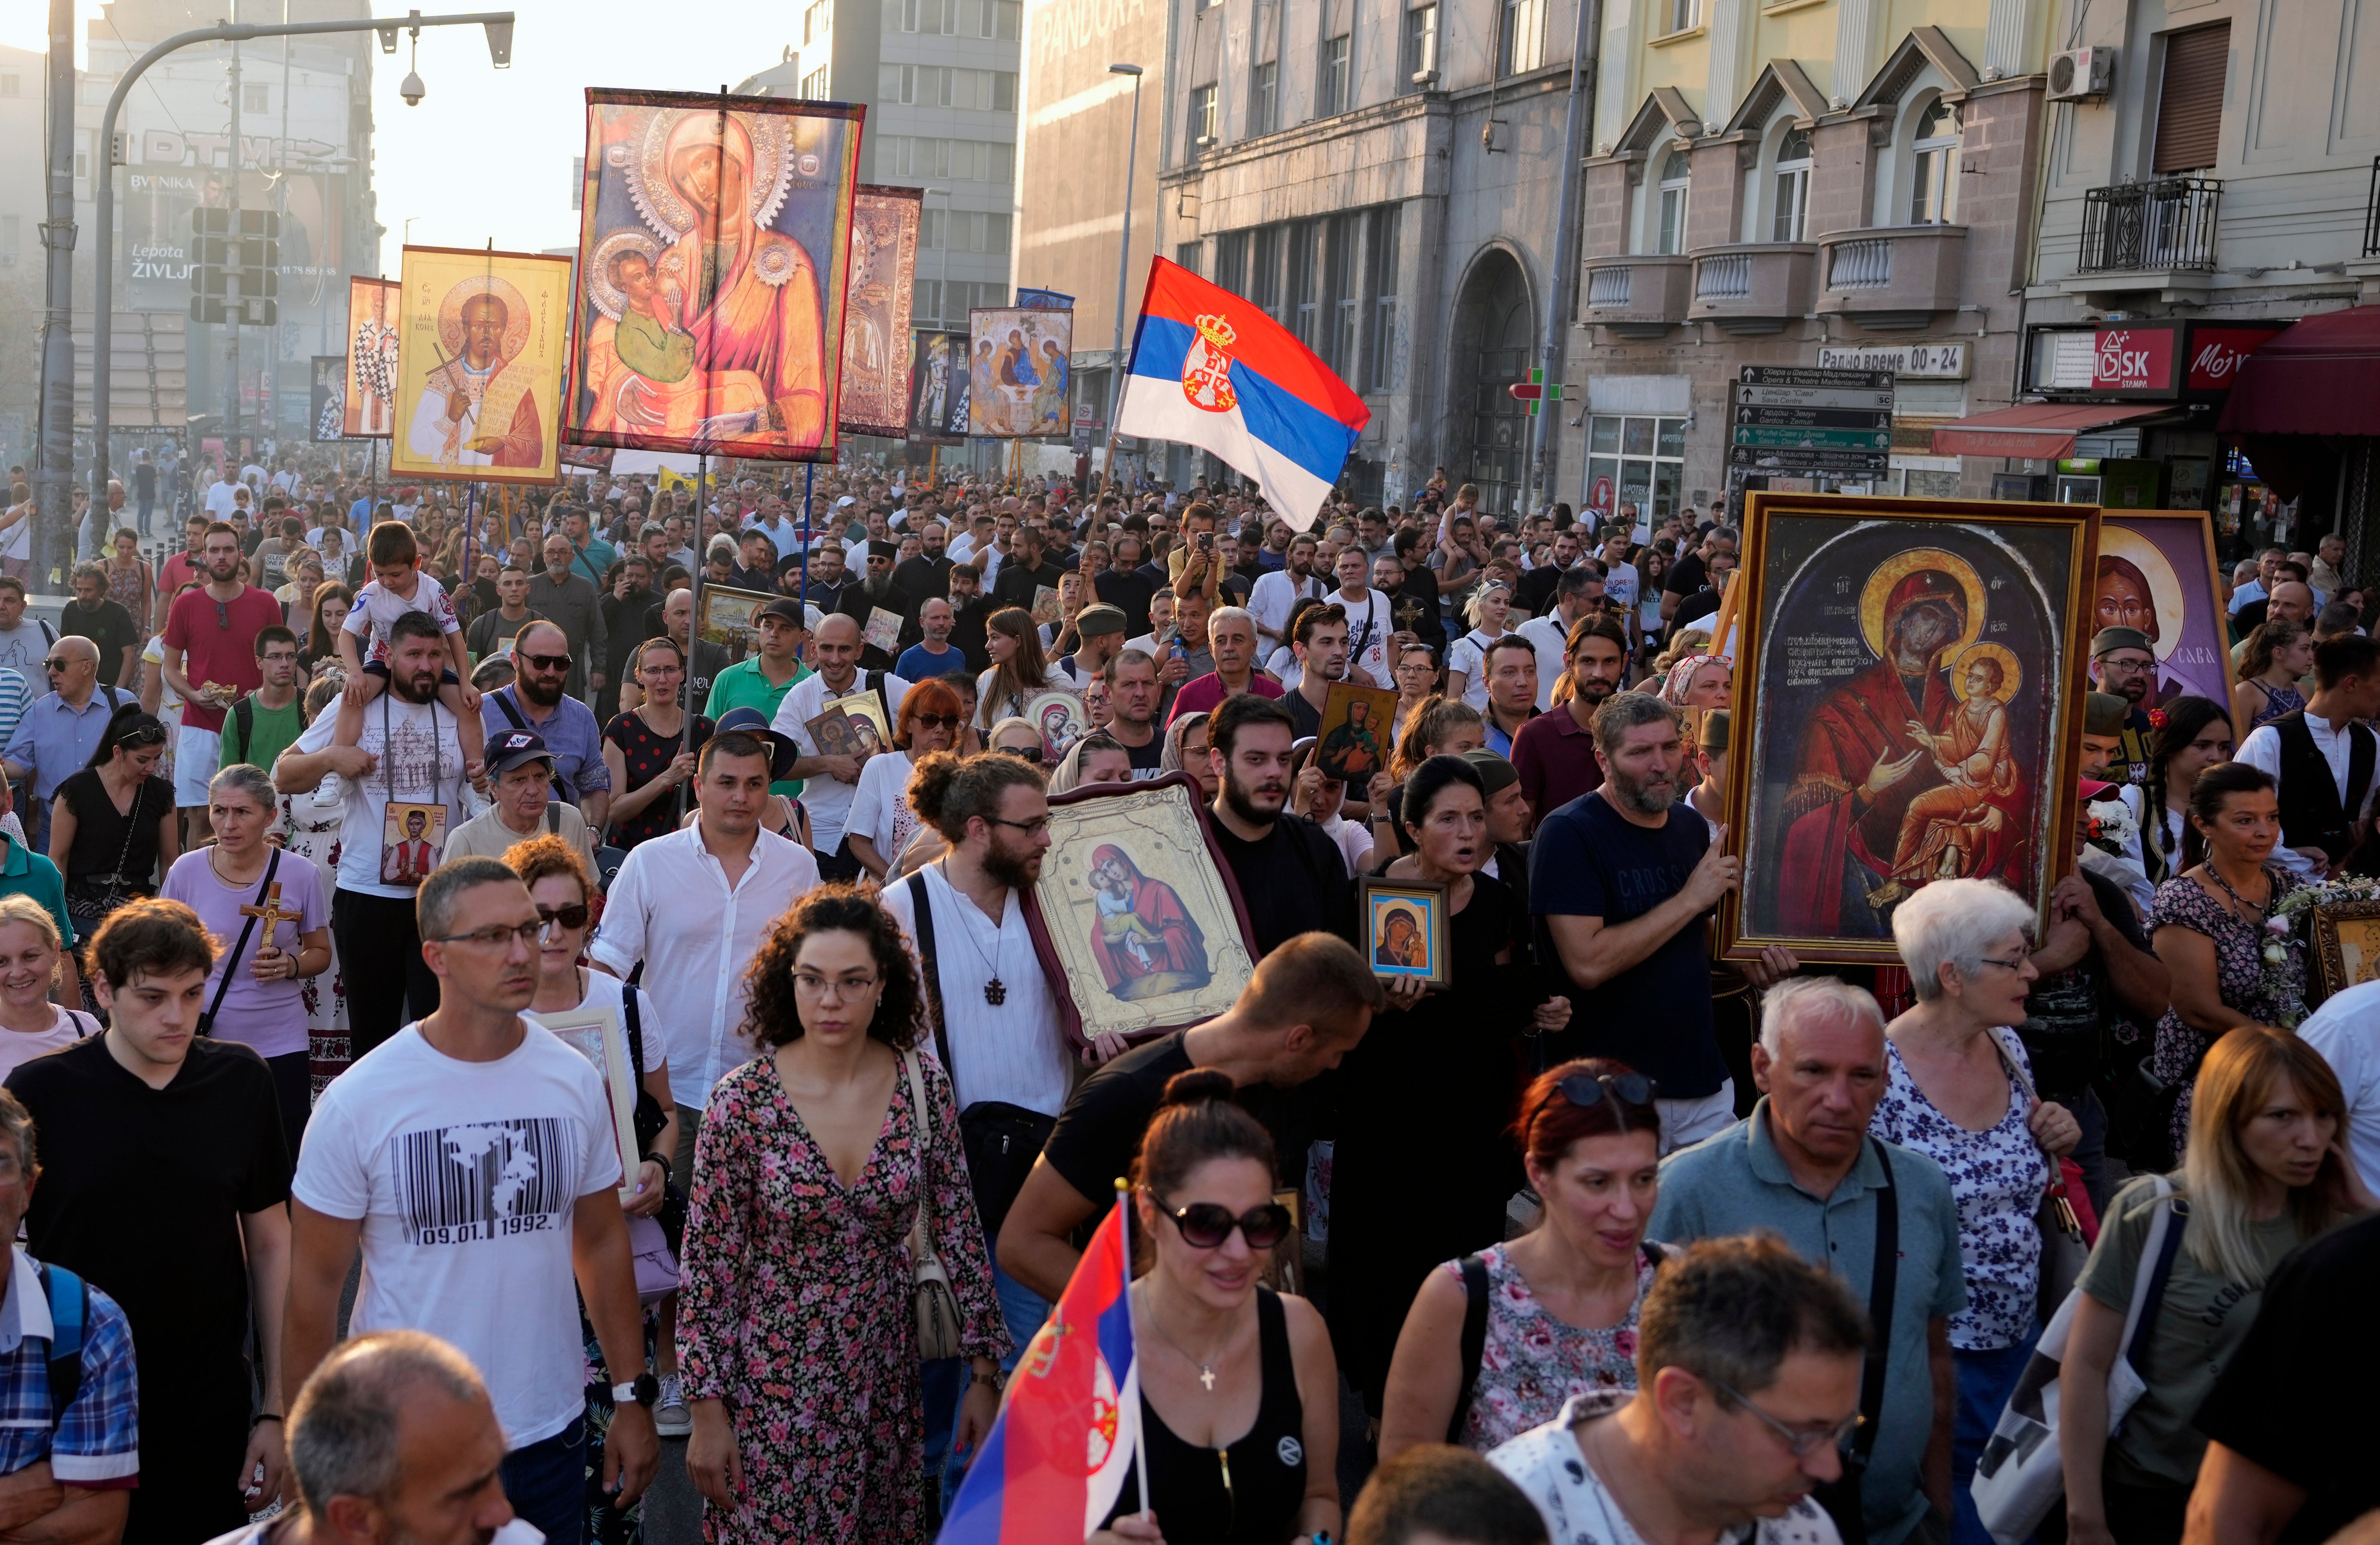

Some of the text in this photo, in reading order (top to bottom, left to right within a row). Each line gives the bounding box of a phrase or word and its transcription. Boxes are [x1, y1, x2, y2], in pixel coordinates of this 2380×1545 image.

[131, 175, 194, 189] BVNIKA
[132, 244, 183, 259] Lepota
[305, 266, 317, 274] 88
[1864, 353, 1905, 370] време
[1911, 348, 1928, 370] 00
[1941, 347, 1957, 370] 24
[2191, 343, 2234, 378] Moj
[1823, 370, 1871, 379] Мадленианум
[1763, 376, 1784, 384] Opera
[2122, 379, 2147, 388] ŠTAMPA
[1794, 410, 1816, 419] Земун
[1661, 434, 1685, 443] APOTEKA
[1813, 460, 1849, 468] pedestrian
[1623, 484, 1650, 495] APOTEKA
[424, 1214, 553, 1245] 09.01. 1992.
